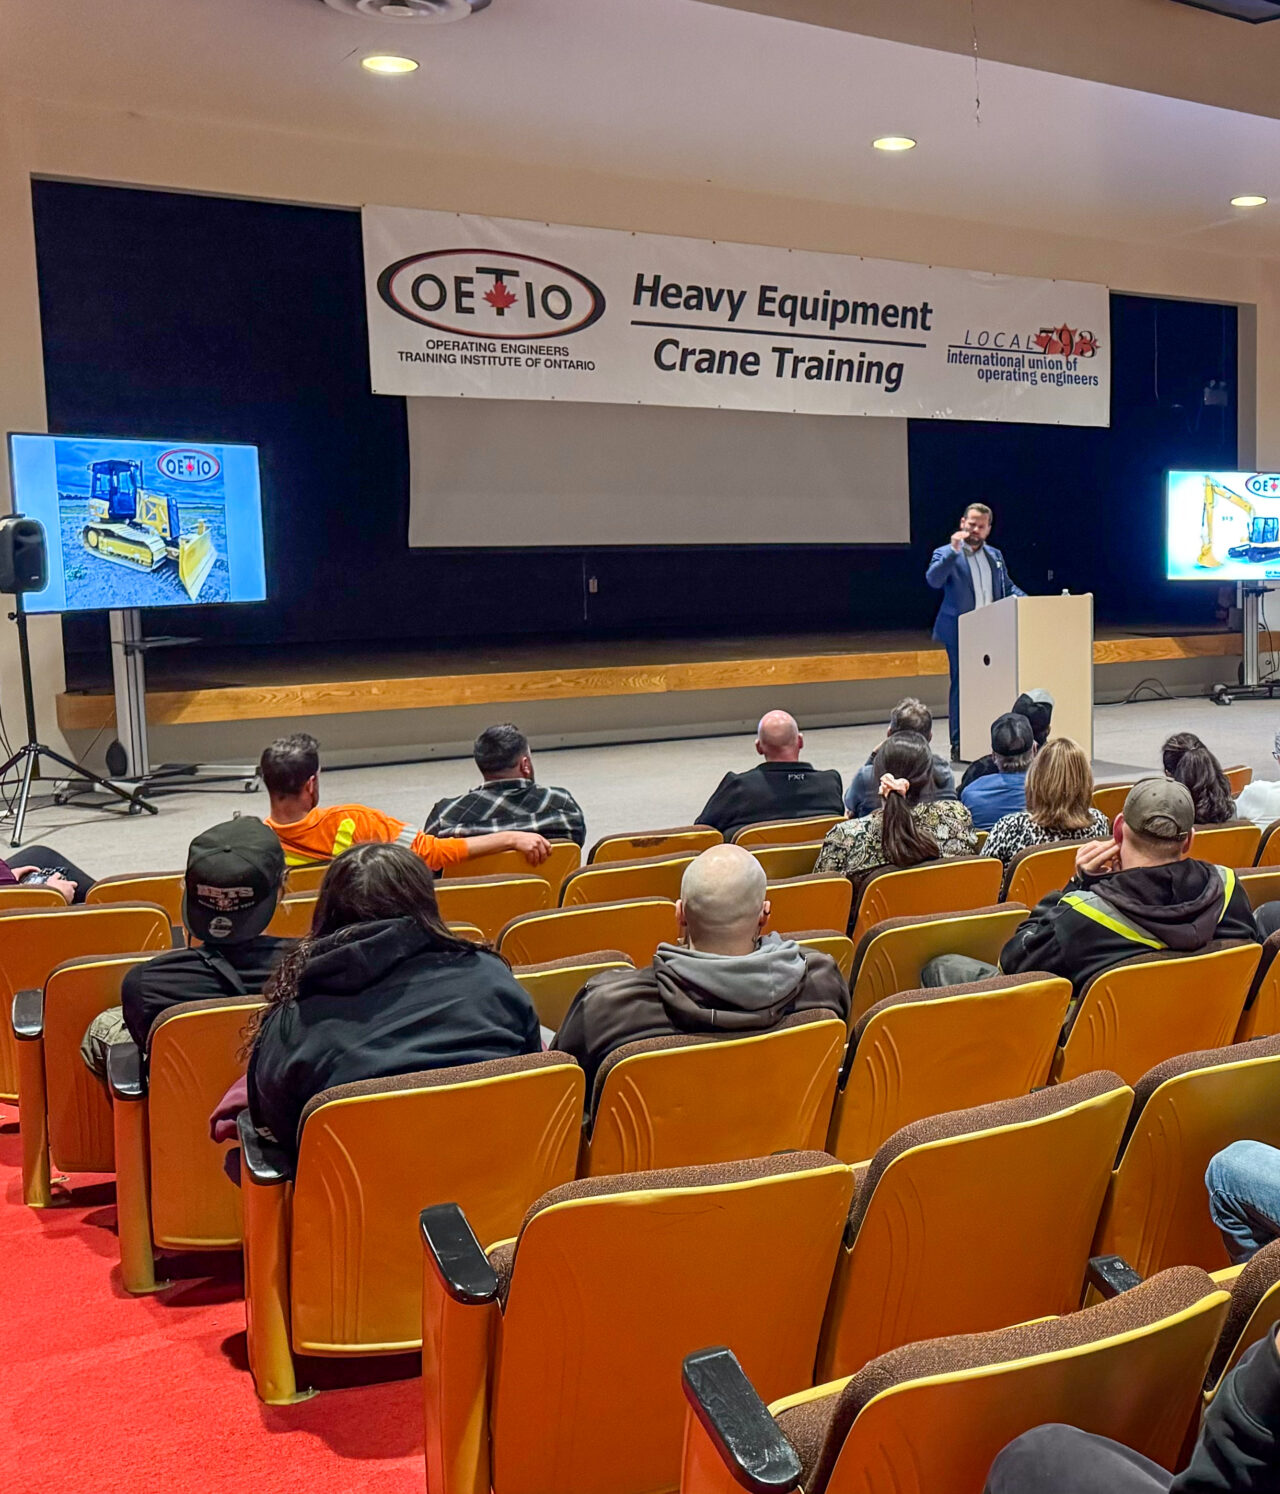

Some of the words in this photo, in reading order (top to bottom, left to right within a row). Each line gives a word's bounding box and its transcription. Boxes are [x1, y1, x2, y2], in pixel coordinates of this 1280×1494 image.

[411, 267, 573, 320] OETIO
[632, 273, 747, 322] Heavy
[757, 285, 933, 331] Equipment
[425, 339, 497, 353] OPERATING
[501, 343, 570, 357] ENGINEERS
[964, 329, 1034, 350] LOCAL
[1039, 327, 1097, 358] 793
[398, 351, 457, 364] TRAINING
[460, 354, 521, 367] INSTITUTE
[525, 357, 542, 368] OF
[544, 359, 596, 371] ONTARIO
[653, 338, 760, 376] Crane
[772, 346, 904, 393] Training
[947, 349, 1025, 368] international
[1028, 358, 1063, 371] union
[1066, 357, 1078, 371] of
[977, 367, 1038, 386] operating
[1040, 371, 1099, 387] engineers
[166, 455, 211, 476] OETIO
